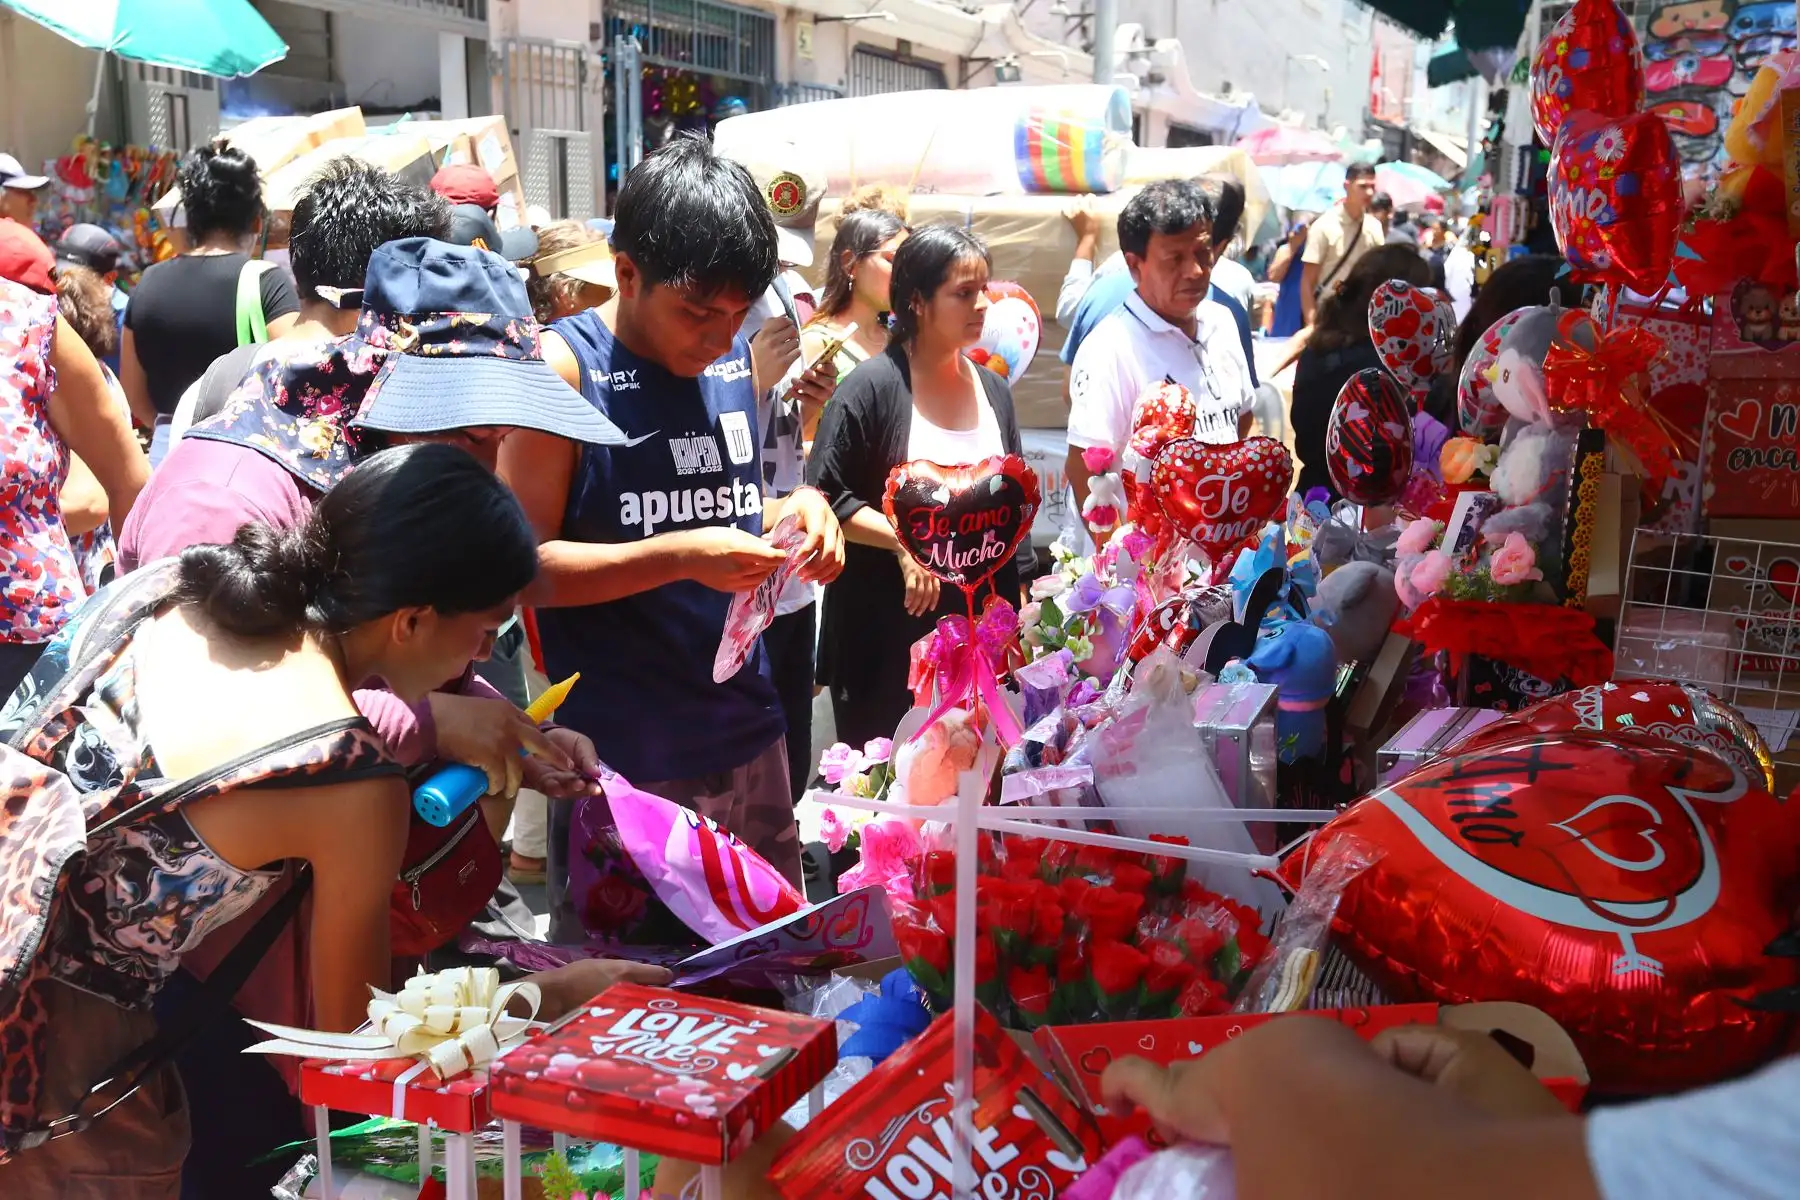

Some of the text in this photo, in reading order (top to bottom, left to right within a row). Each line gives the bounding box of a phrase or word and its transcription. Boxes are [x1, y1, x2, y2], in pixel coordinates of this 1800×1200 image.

[619, 477, 763, 537] apuesta
[1195, 471, 1250, 519] Te
[908, 505, 951, 541] Te
[958, 505, 1011, 535] amo
[1190, 516, 1258, 543] amo
[924, 532, 1006, 569] Mucho
[1408, 738, 1574, 848] Amo
[590, 1030, 697, 1062] me
[607, 1008, 758, 1054] LOVE
